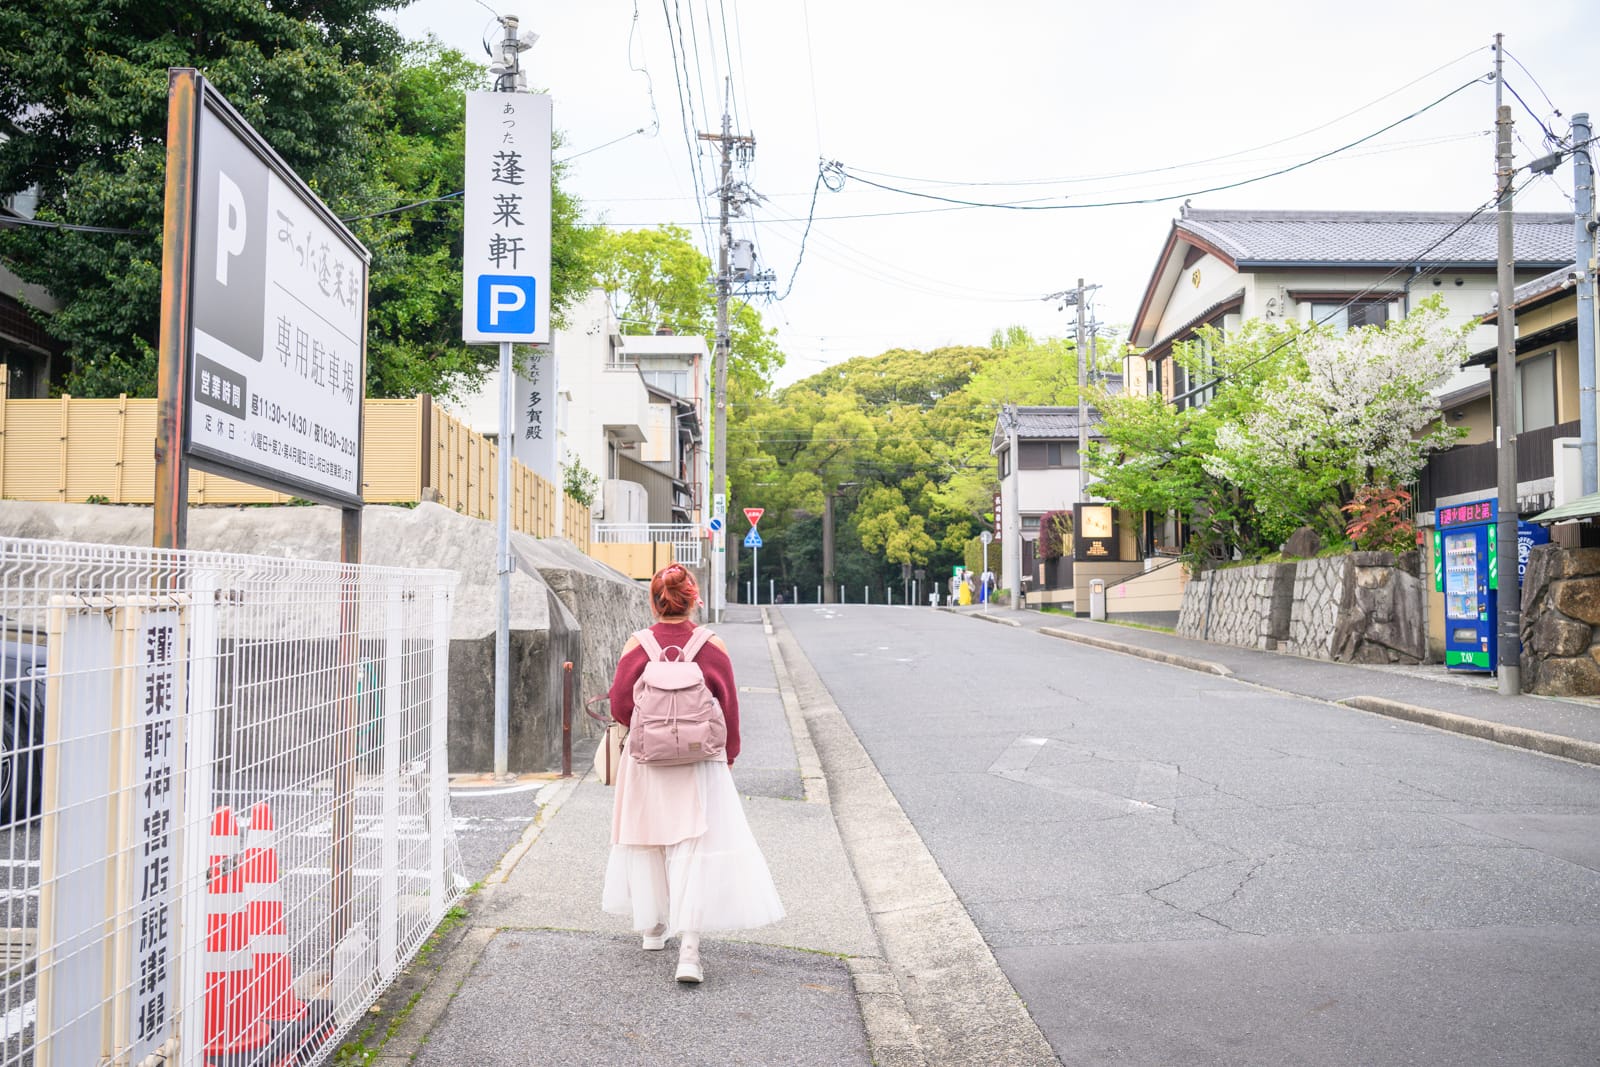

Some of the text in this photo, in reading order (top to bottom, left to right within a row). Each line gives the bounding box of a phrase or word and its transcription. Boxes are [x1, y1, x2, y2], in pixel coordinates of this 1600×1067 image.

[488, 102, 526, 270] あつた 蓬莱軒
[216, 169, 247, 286] P
[490, 285, 526, 325] P
[201, 370, 240, 409] 営業時間
[276, 315, 354, 407] 専用駐車場
[525, 391, 543, 440] 多賀殿
